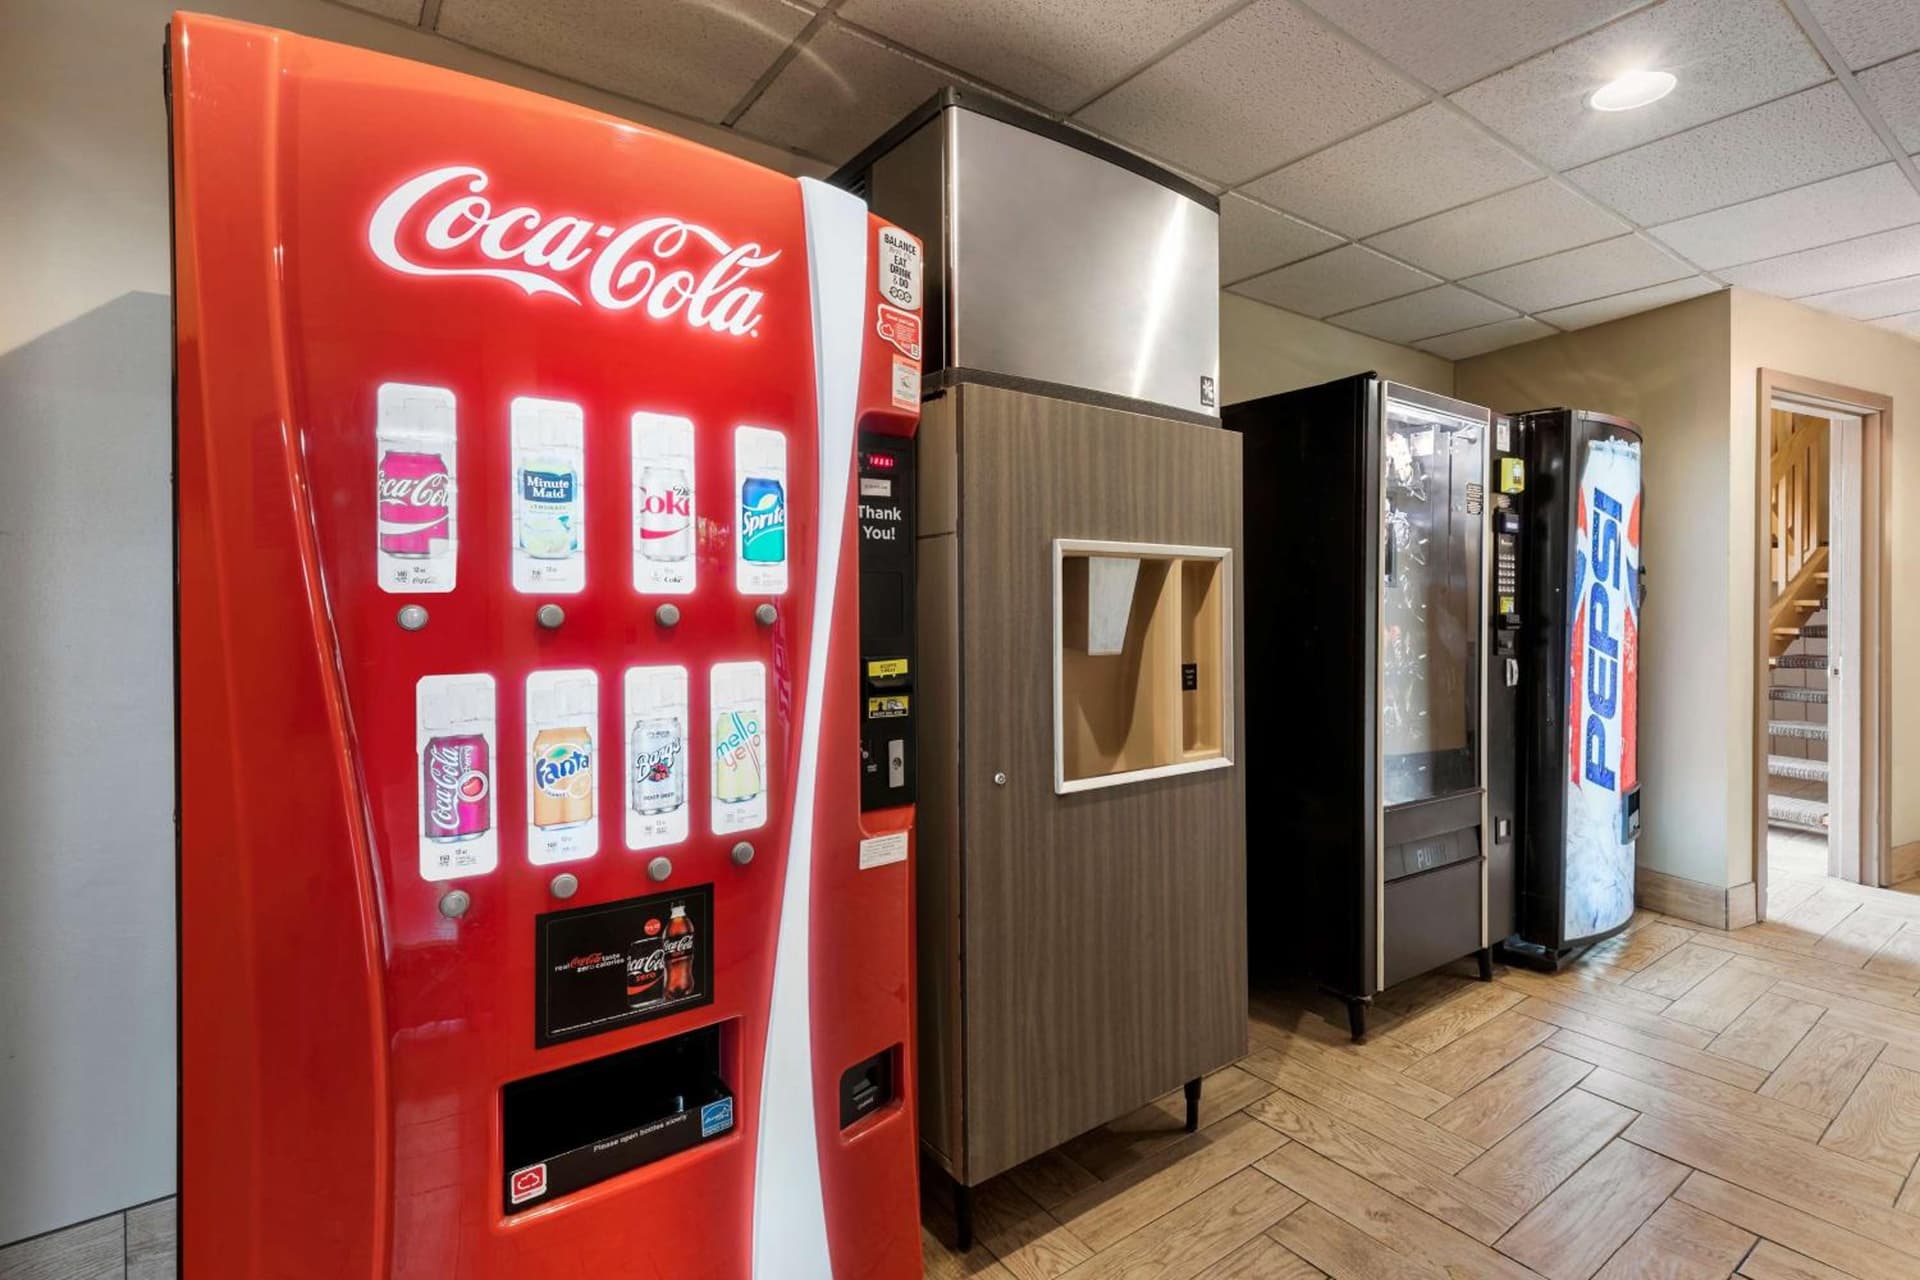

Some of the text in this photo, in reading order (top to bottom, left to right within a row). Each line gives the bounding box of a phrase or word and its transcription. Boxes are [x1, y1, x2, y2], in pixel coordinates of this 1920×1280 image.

[368, 166, 782, 337] Coca-Cola
[884, 233, 917, 256] BALANCE
[894, 255, 907, 267] EAT
[890, 264, 912, 280] DRINK
[899, 278, 909, 289] DO
[527, 475, 569, 489] Minute
[532, 485, 565, 498] Maid
[742, 508, 784, 535] Sprite
[858, 505, 901, 520] Thank
[863, 525, 895, 541] You!
[1586, 487, 1623, 792] PEPSI
[716, 711, 758, 758] mello
[725, 734, 761, 779] yello
[430, 744, 460, 830] Coca-Cola
[554, 962, 570, 972] real
[602, 953, 620, 962] taste
[577, 958, 625, 973] zero calories
[593, 1114, 687, 1152] Please open bottles slowly
